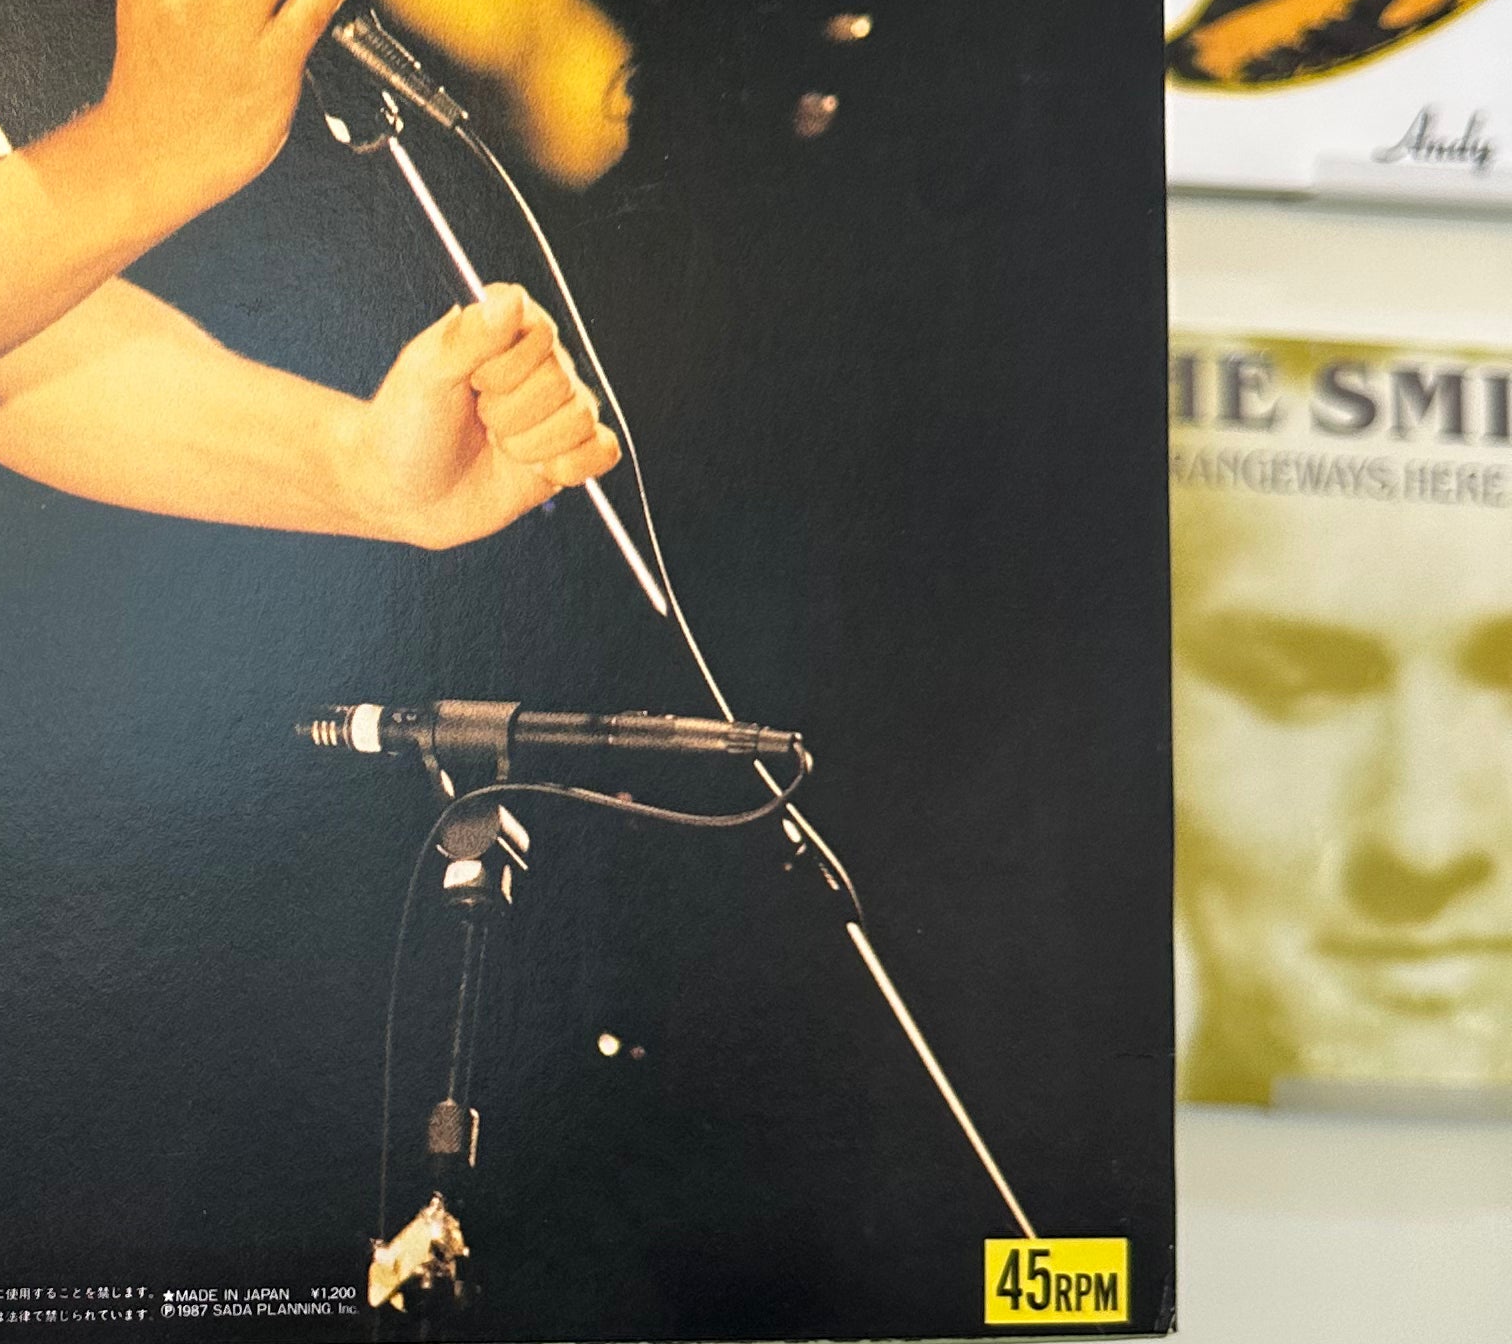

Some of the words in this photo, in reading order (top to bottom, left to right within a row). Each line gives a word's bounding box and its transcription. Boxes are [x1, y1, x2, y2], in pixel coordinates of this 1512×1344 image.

[224, 1289, 238, 1301] IN
[243, 1288, 290, 1301] JAPAN
[311, 1286, 357, 1300] ¥1,200
[213, 1304, 253, 1317] SADA
